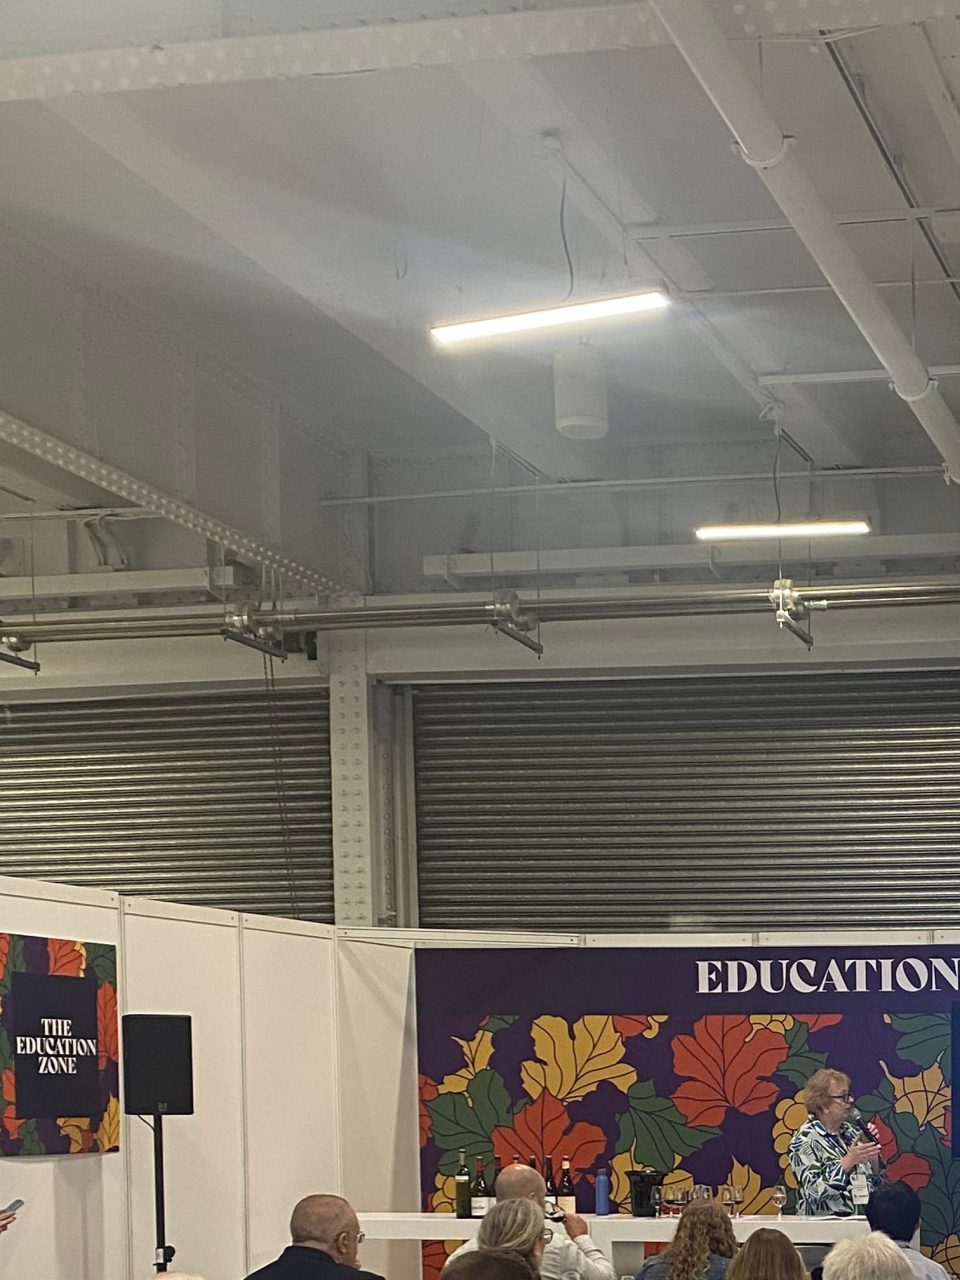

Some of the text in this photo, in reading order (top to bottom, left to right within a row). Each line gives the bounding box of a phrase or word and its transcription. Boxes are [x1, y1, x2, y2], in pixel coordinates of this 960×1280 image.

[695, 957, 960, 993] EDUCATION
[41, 1018, 72, 1036] THE
[16, 1037, 97, 1056] EDUCATION
[38, 1056, 77, 1074] ZONE
